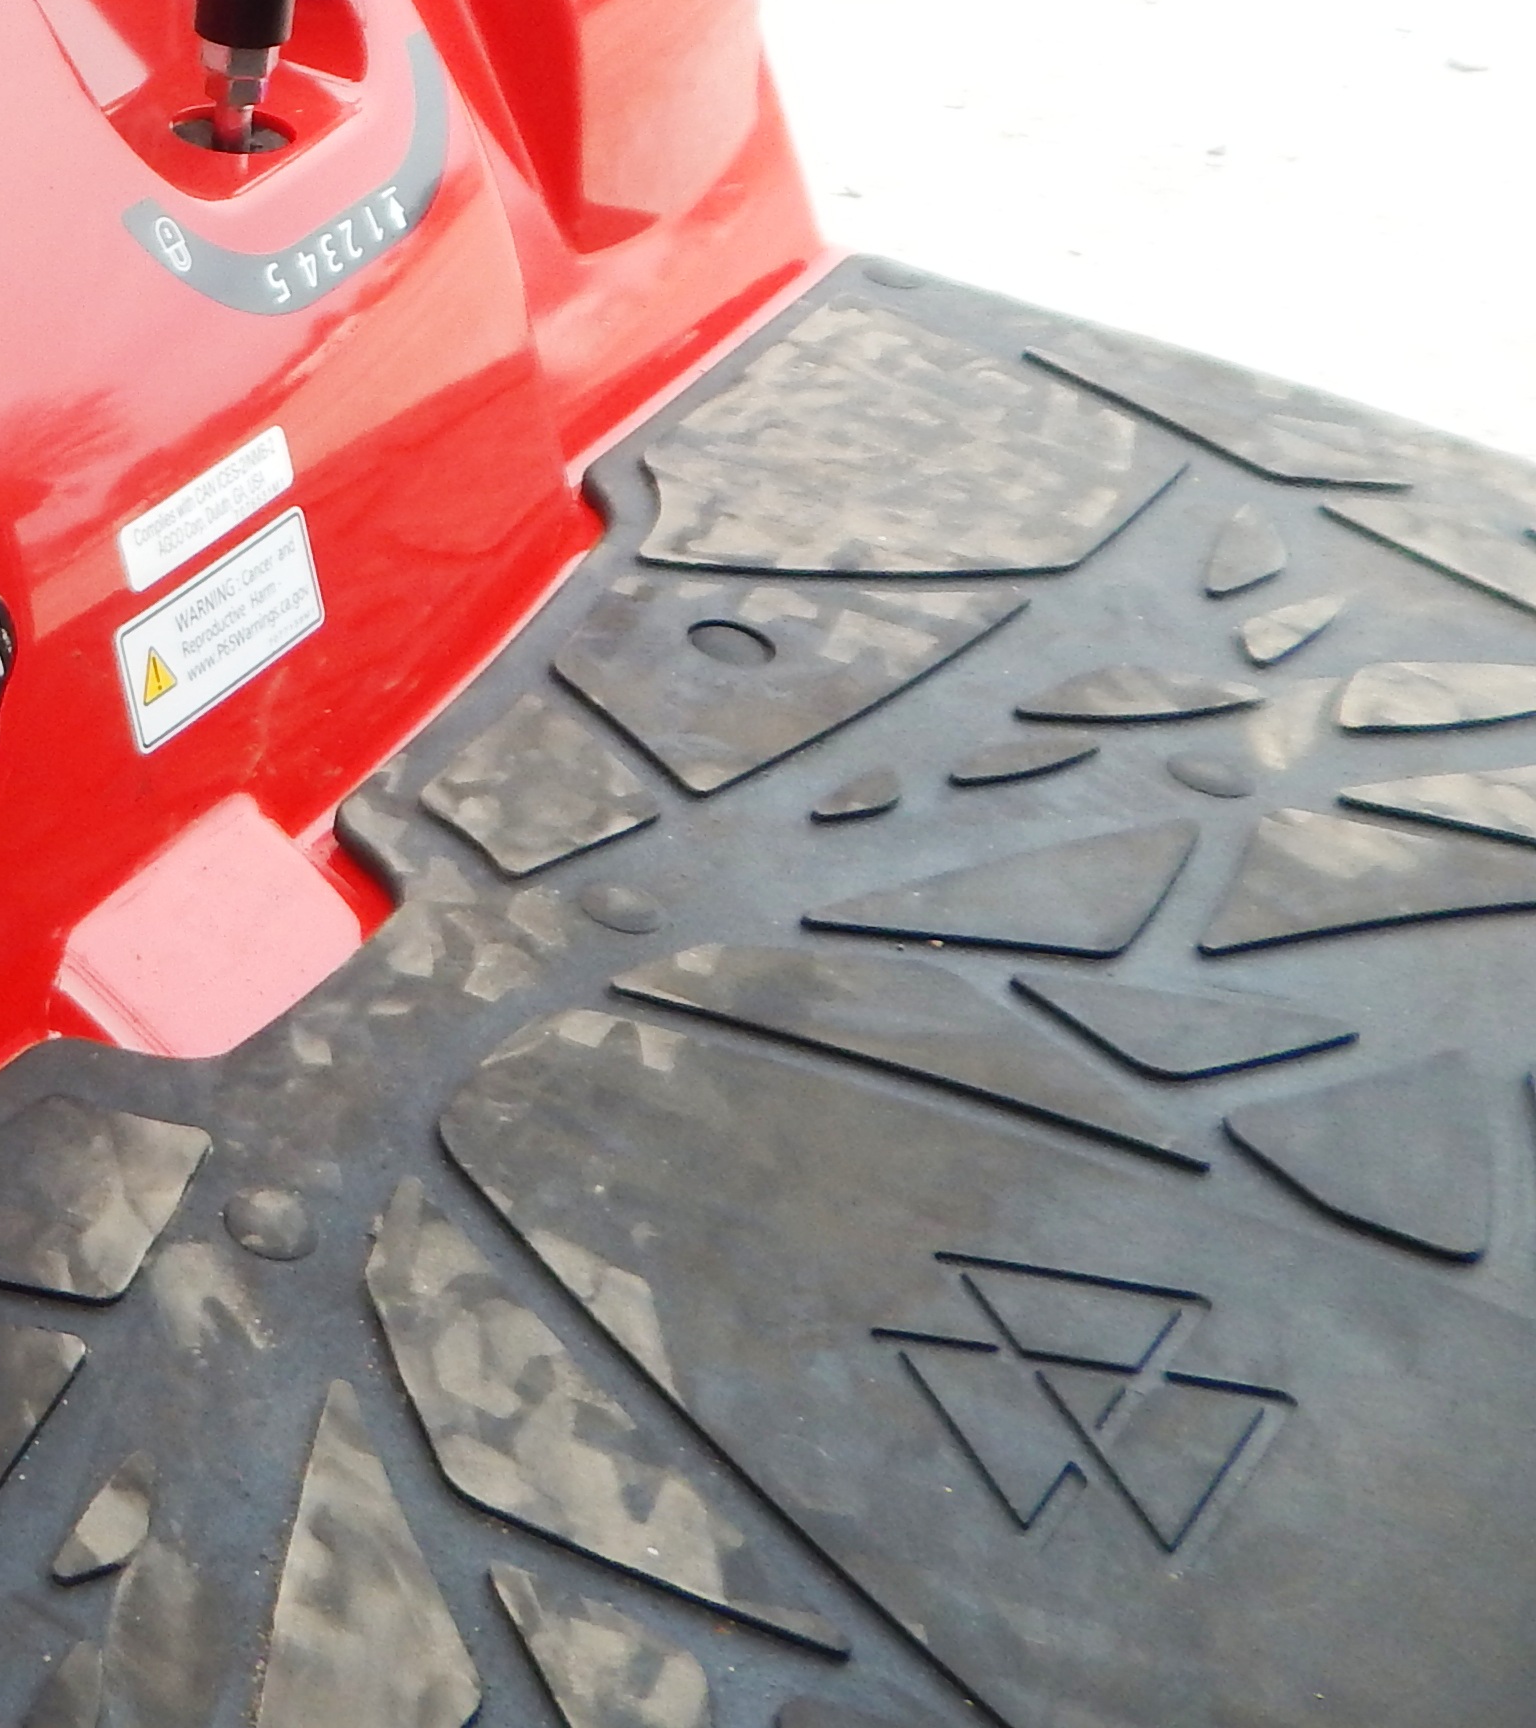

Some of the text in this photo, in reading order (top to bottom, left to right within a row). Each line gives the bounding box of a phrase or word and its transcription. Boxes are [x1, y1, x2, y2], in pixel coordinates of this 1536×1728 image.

[240, 553, 275, 587] Cancer
[276, 535, 296, 563] and
[181, 603, 247, 659] Reproductive
[248, 580, 276, 609] Harm
